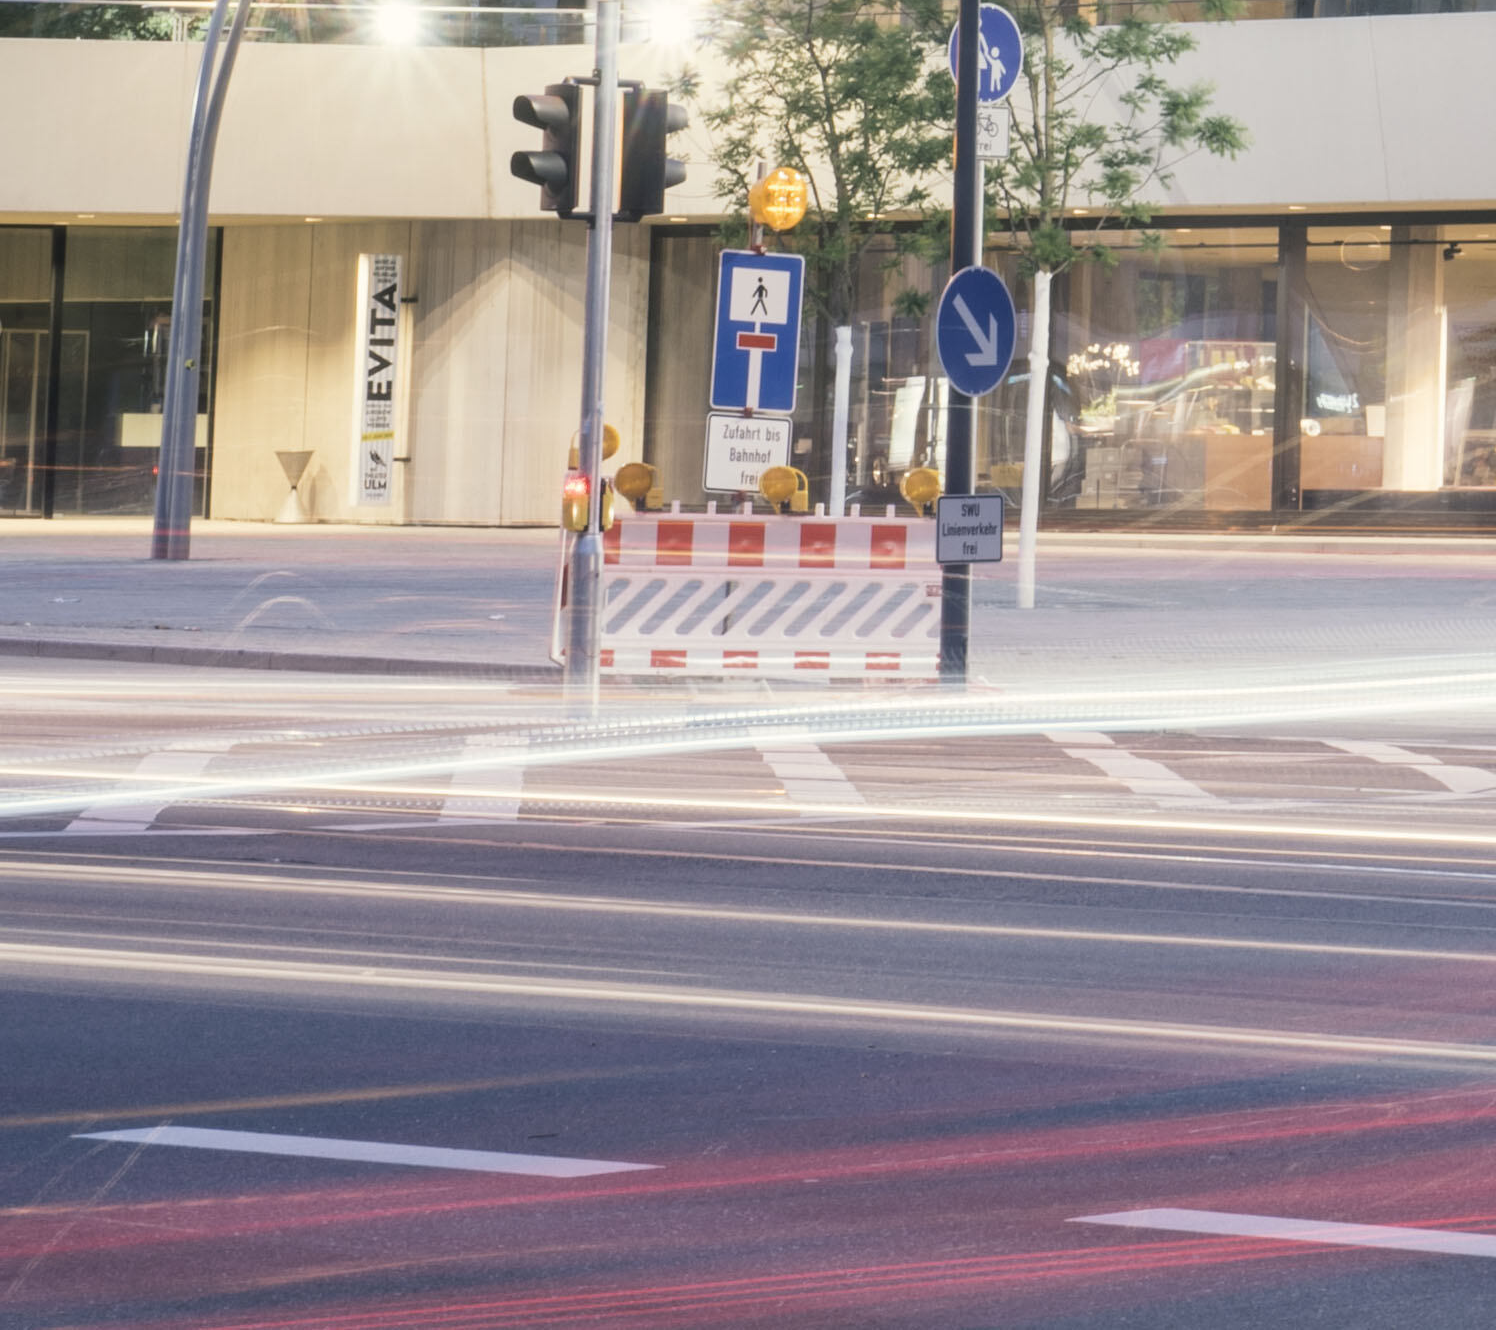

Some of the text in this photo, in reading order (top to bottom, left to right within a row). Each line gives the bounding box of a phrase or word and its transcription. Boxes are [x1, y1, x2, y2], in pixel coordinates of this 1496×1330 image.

[977, 141, 992, 151] rei
[367, 283, 397, 401] EVITA
[723, 424, 780, 441] Zufahrt bis
[729, 447, 771, 463] Bahnhof
[364, 479, 387, 490] ULM
[740, 471, 759, 485] frei
[961, 504, 980, 517] SWU
[942, 523, 998, 537] Linienverkehr
[963, 542, 978, 555] frei
